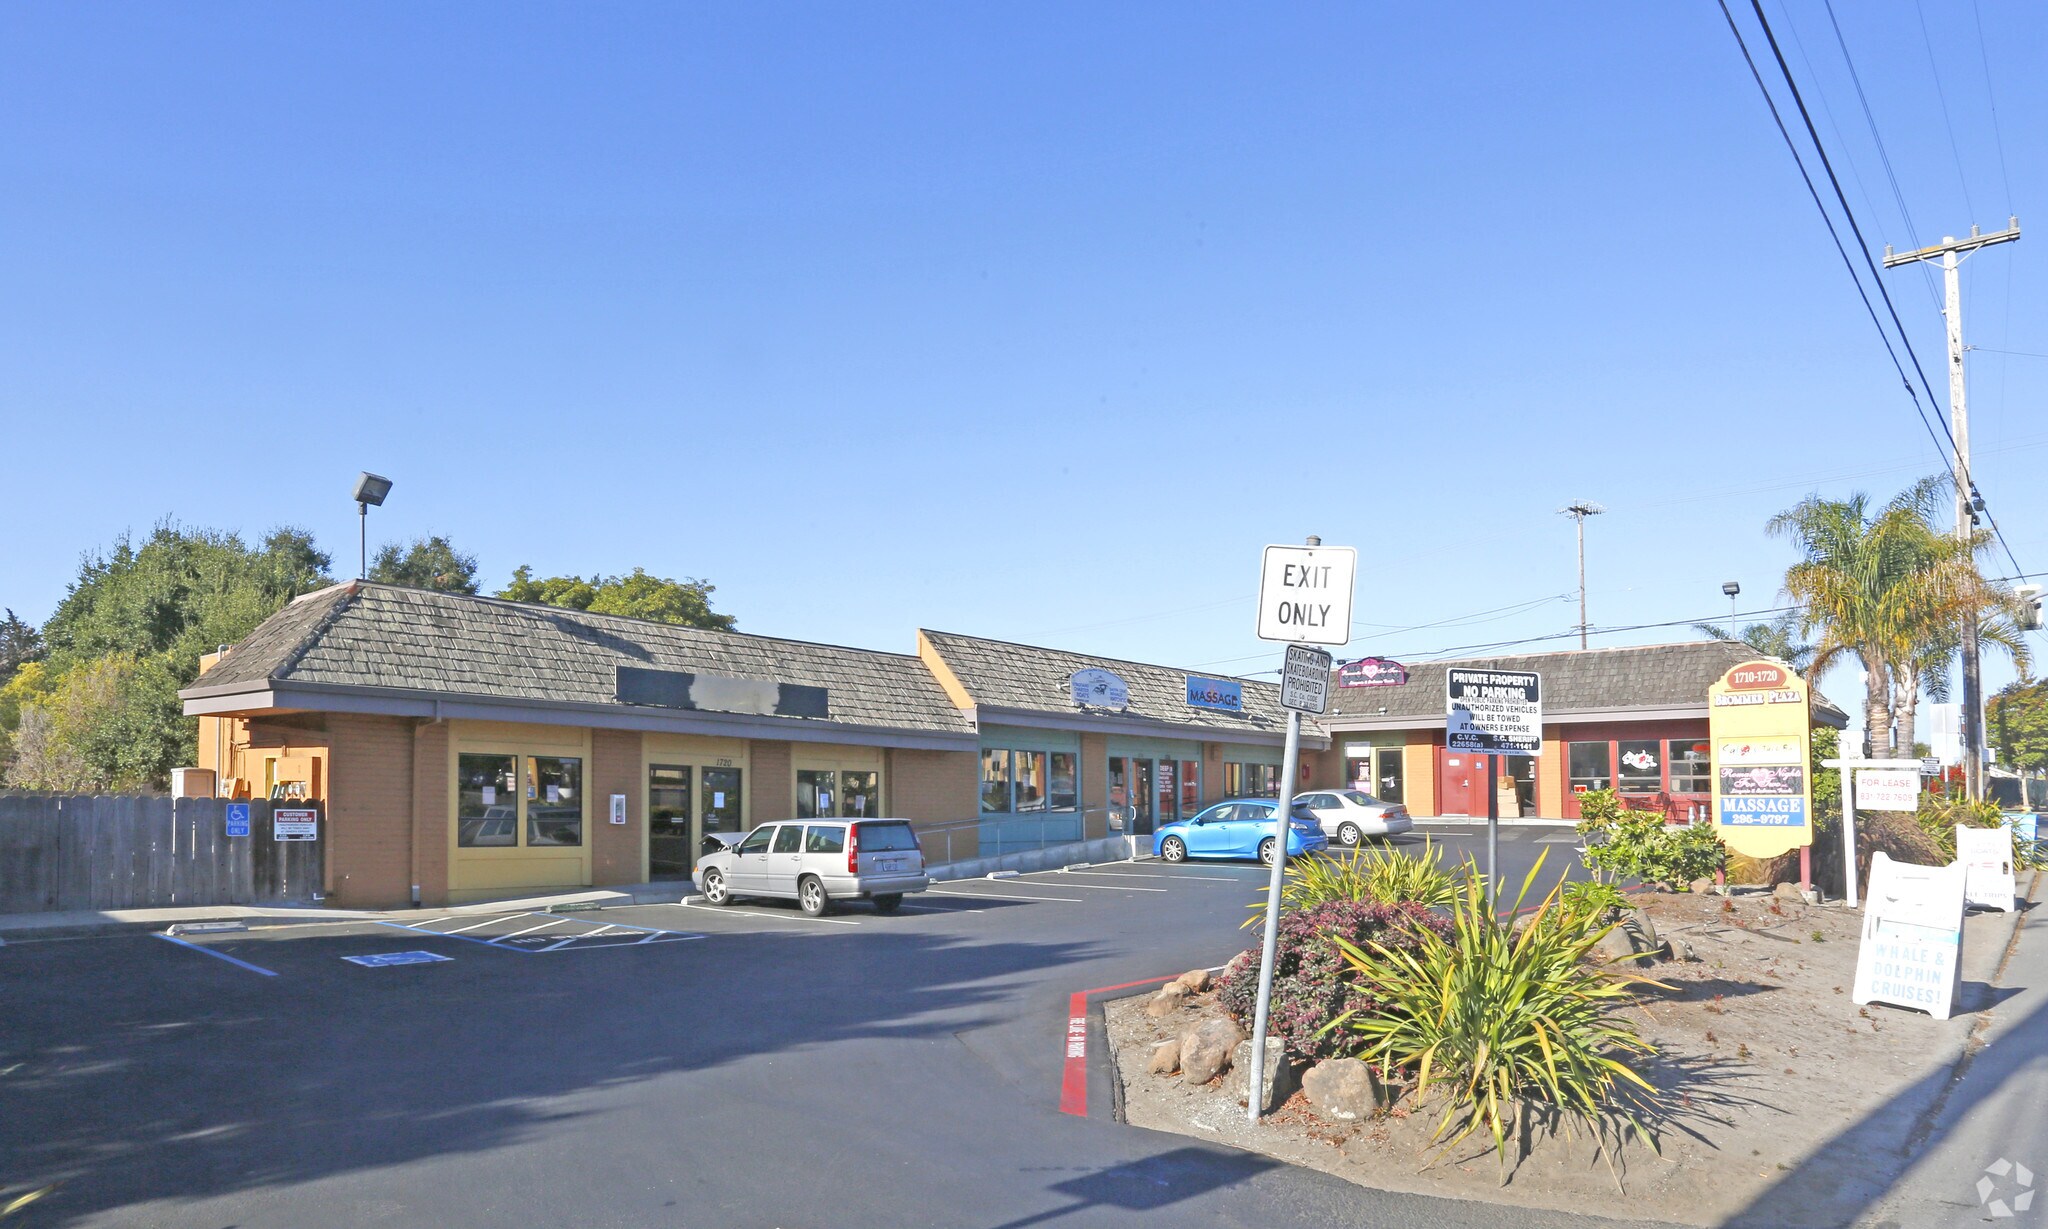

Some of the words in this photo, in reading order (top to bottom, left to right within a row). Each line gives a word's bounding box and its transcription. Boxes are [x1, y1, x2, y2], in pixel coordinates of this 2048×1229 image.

[1283, 563, 1332, 589] EXIT
[1278, 601, 1331, 627] ONLY
[1289, 648, 1314, 665] SKATING
[1315, 655, 1329, 668] AND
[1287, 662, 1327, 682] SKATEBOARDING
[1734, 670, 1778, 684] 1710-1720
[1287, 676, 1323, 695] PROHIBITED
[1452, 672, 1489, 685] PRIVATE
[1489, 674, 1535, 687] PROPERTY
[1190, 689, 1238, 707] MASSAGE
[1463, 685, 1479, 697] NO
[1481, 686, 1526, 699] PARKING
[1452, 702, 1504, 713] UNAUTHORIZED
[1506, 705, 1538, 714] VEHICLES
[1469, 713, 1485, 722] WILL
[1486, 714, 1495, 722] BE
[1497, 714, 1521, 723] TOWED
[1460, 722, 1469, 731] AT
[1470, 723, 1498, 732] OWNERS
[1500, 724, 1530, 733] EXPENSE
[1452, 740, 1484, 748] 22658(a)
[716, 758, 732, 767] 1720
[1769, 767, 1802, 780] Nights
[1861, 778, 1880, 787] FOR
[1882, 779, 1911, 788] LEASE
[1722, 798, 1800, 812] MASSAGE
[227, 819, 248, 827] PARKING
[1875, 943, 1928, 963] WHALE
[1935, 952, 1945, 966] &
[1873, 961, 1942, 985] DOLPHIN
[1871, 980, 1941, 1005] CRUISES!
